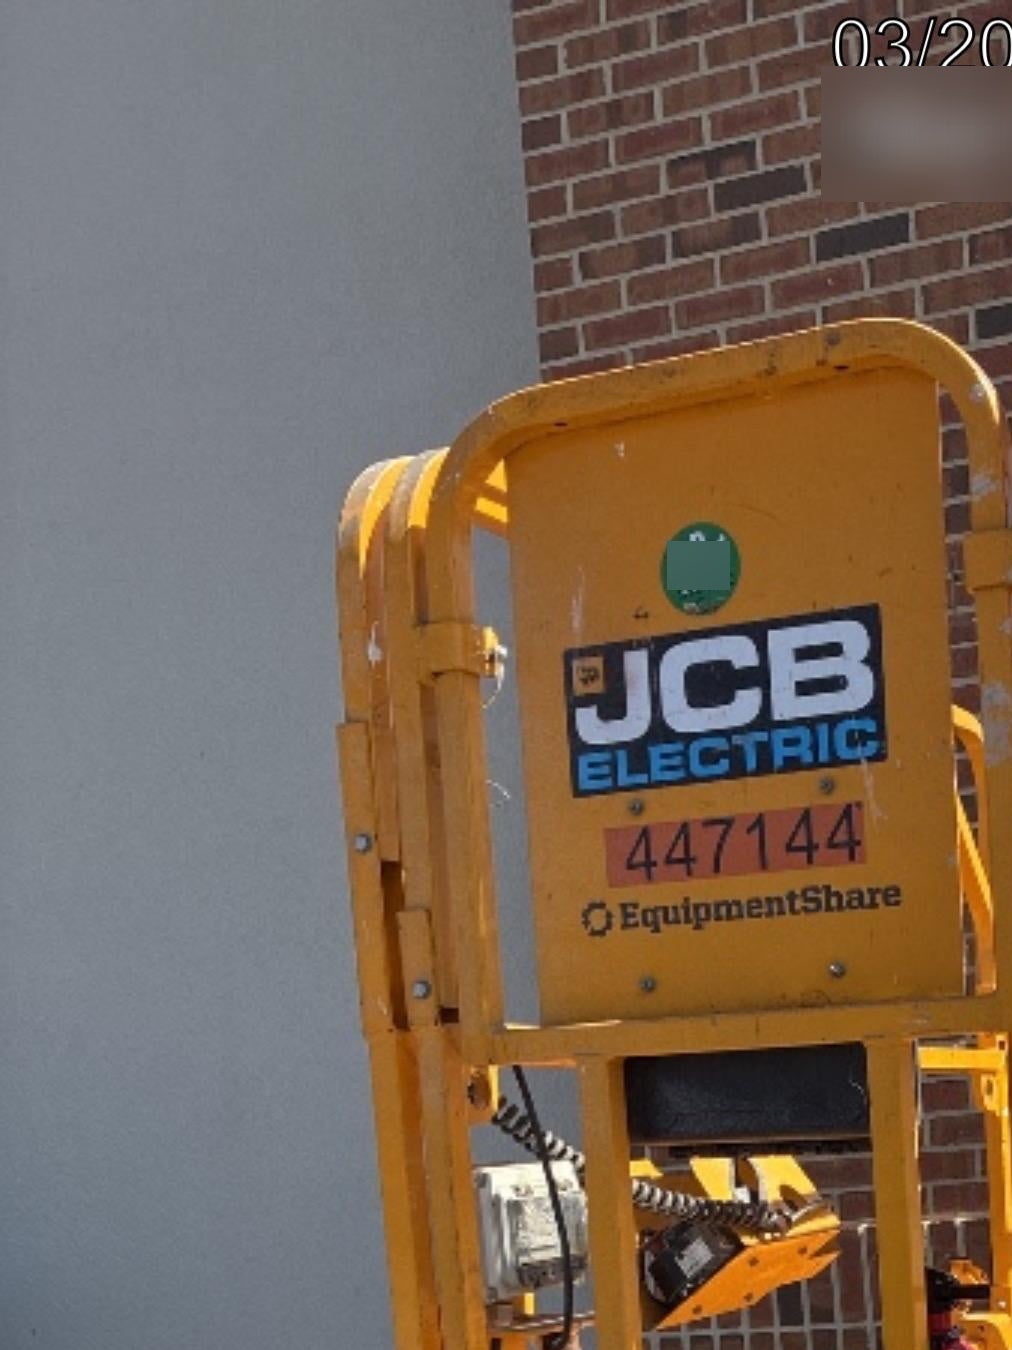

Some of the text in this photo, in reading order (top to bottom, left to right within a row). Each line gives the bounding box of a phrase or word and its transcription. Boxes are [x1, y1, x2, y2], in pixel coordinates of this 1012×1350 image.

[574, 620, 876, 746] JCB
[578, 719, 881, 792] ELECTRIC
[625, 803, 863, 881] 447144
[620, 884, 902, 934] EquipmentShare
